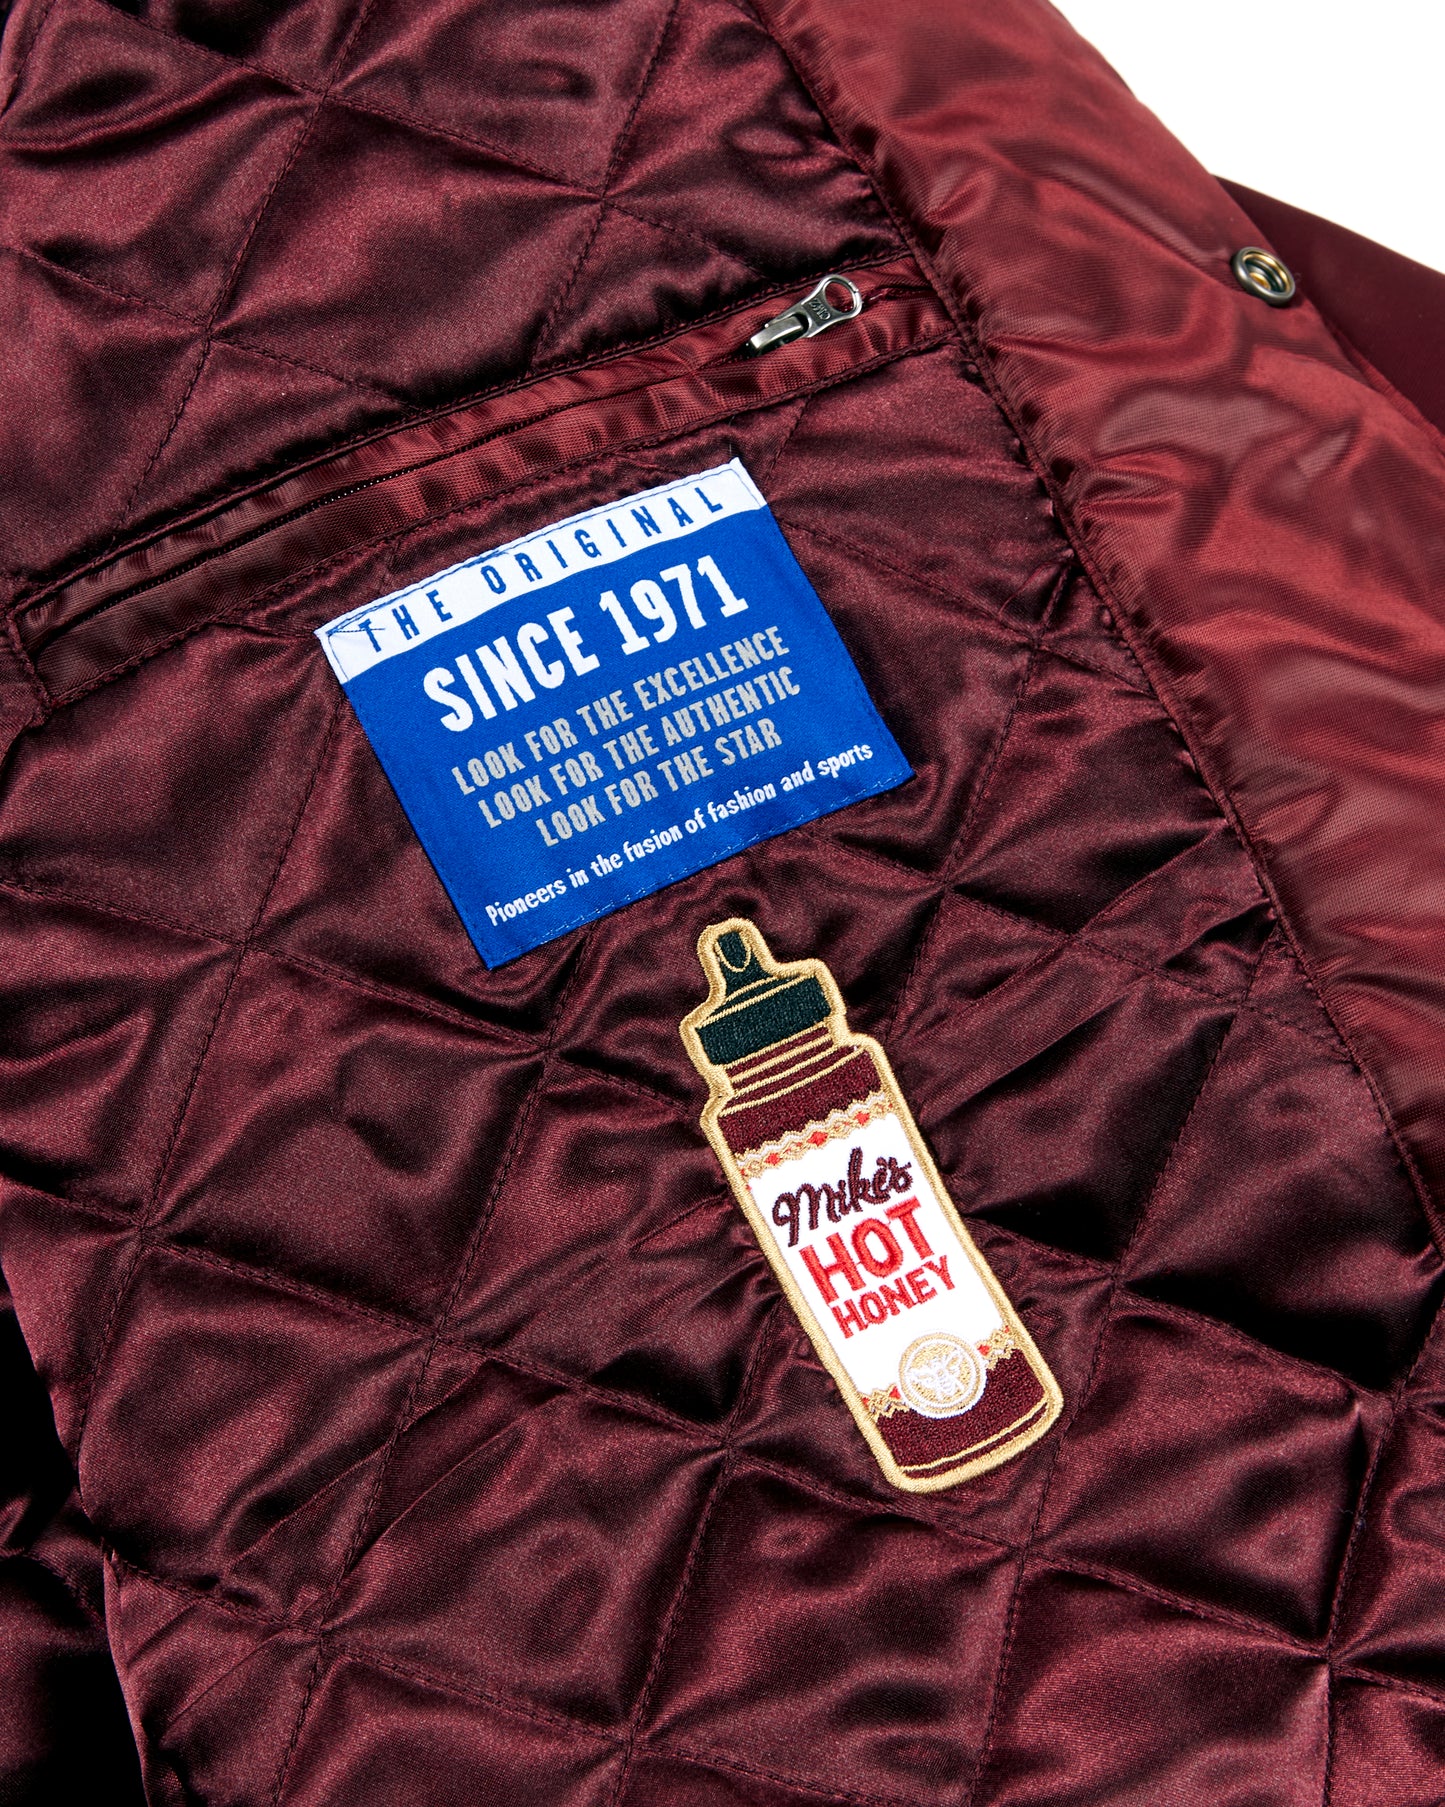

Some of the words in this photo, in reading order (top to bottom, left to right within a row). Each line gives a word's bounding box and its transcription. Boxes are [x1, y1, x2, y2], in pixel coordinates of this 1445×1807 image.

[358, 589, 453, 653] THE
[480, 487, 723, 594] ORIGINAL
[423, 607, 600, 732] SINCE
[599, 555, 749, 655] 1971
[451, 742, 526, 796] LOOK
[524, 718, 579, 762] FOR
[576, 690, 634, 736] THE
[633, 625, 790, 711] EXCELLENCE
[477, 775, 552, 829] LOOK
[549, 750, 604, 796] FOR
[602, 724, 660, 771] THE
[661, 666, 801, 747] AUTHENTIC
[535, 795, 607, 847] LOOK
[603, 770, 659, 816] FOR
[656, 745, 715, 792] THE
[715, 717, 783, 766] STAR
[485, 879, 567, 927] Pioneers
[566, 867, 590, 889] in
[590, 853, 624, 877] the
[623, 824, 684, 863] fusion
[684, 807, 707, 834] of
[707, 782, 777, 823] fashion
[780, 760, 816, 792] and
[816, 744, 874, 779] sports
[772, 1147, 913, 1247] Mike's
[799, 1195, 934, 1304] HOT
[831, 1255, 956, 1339] HONEY
